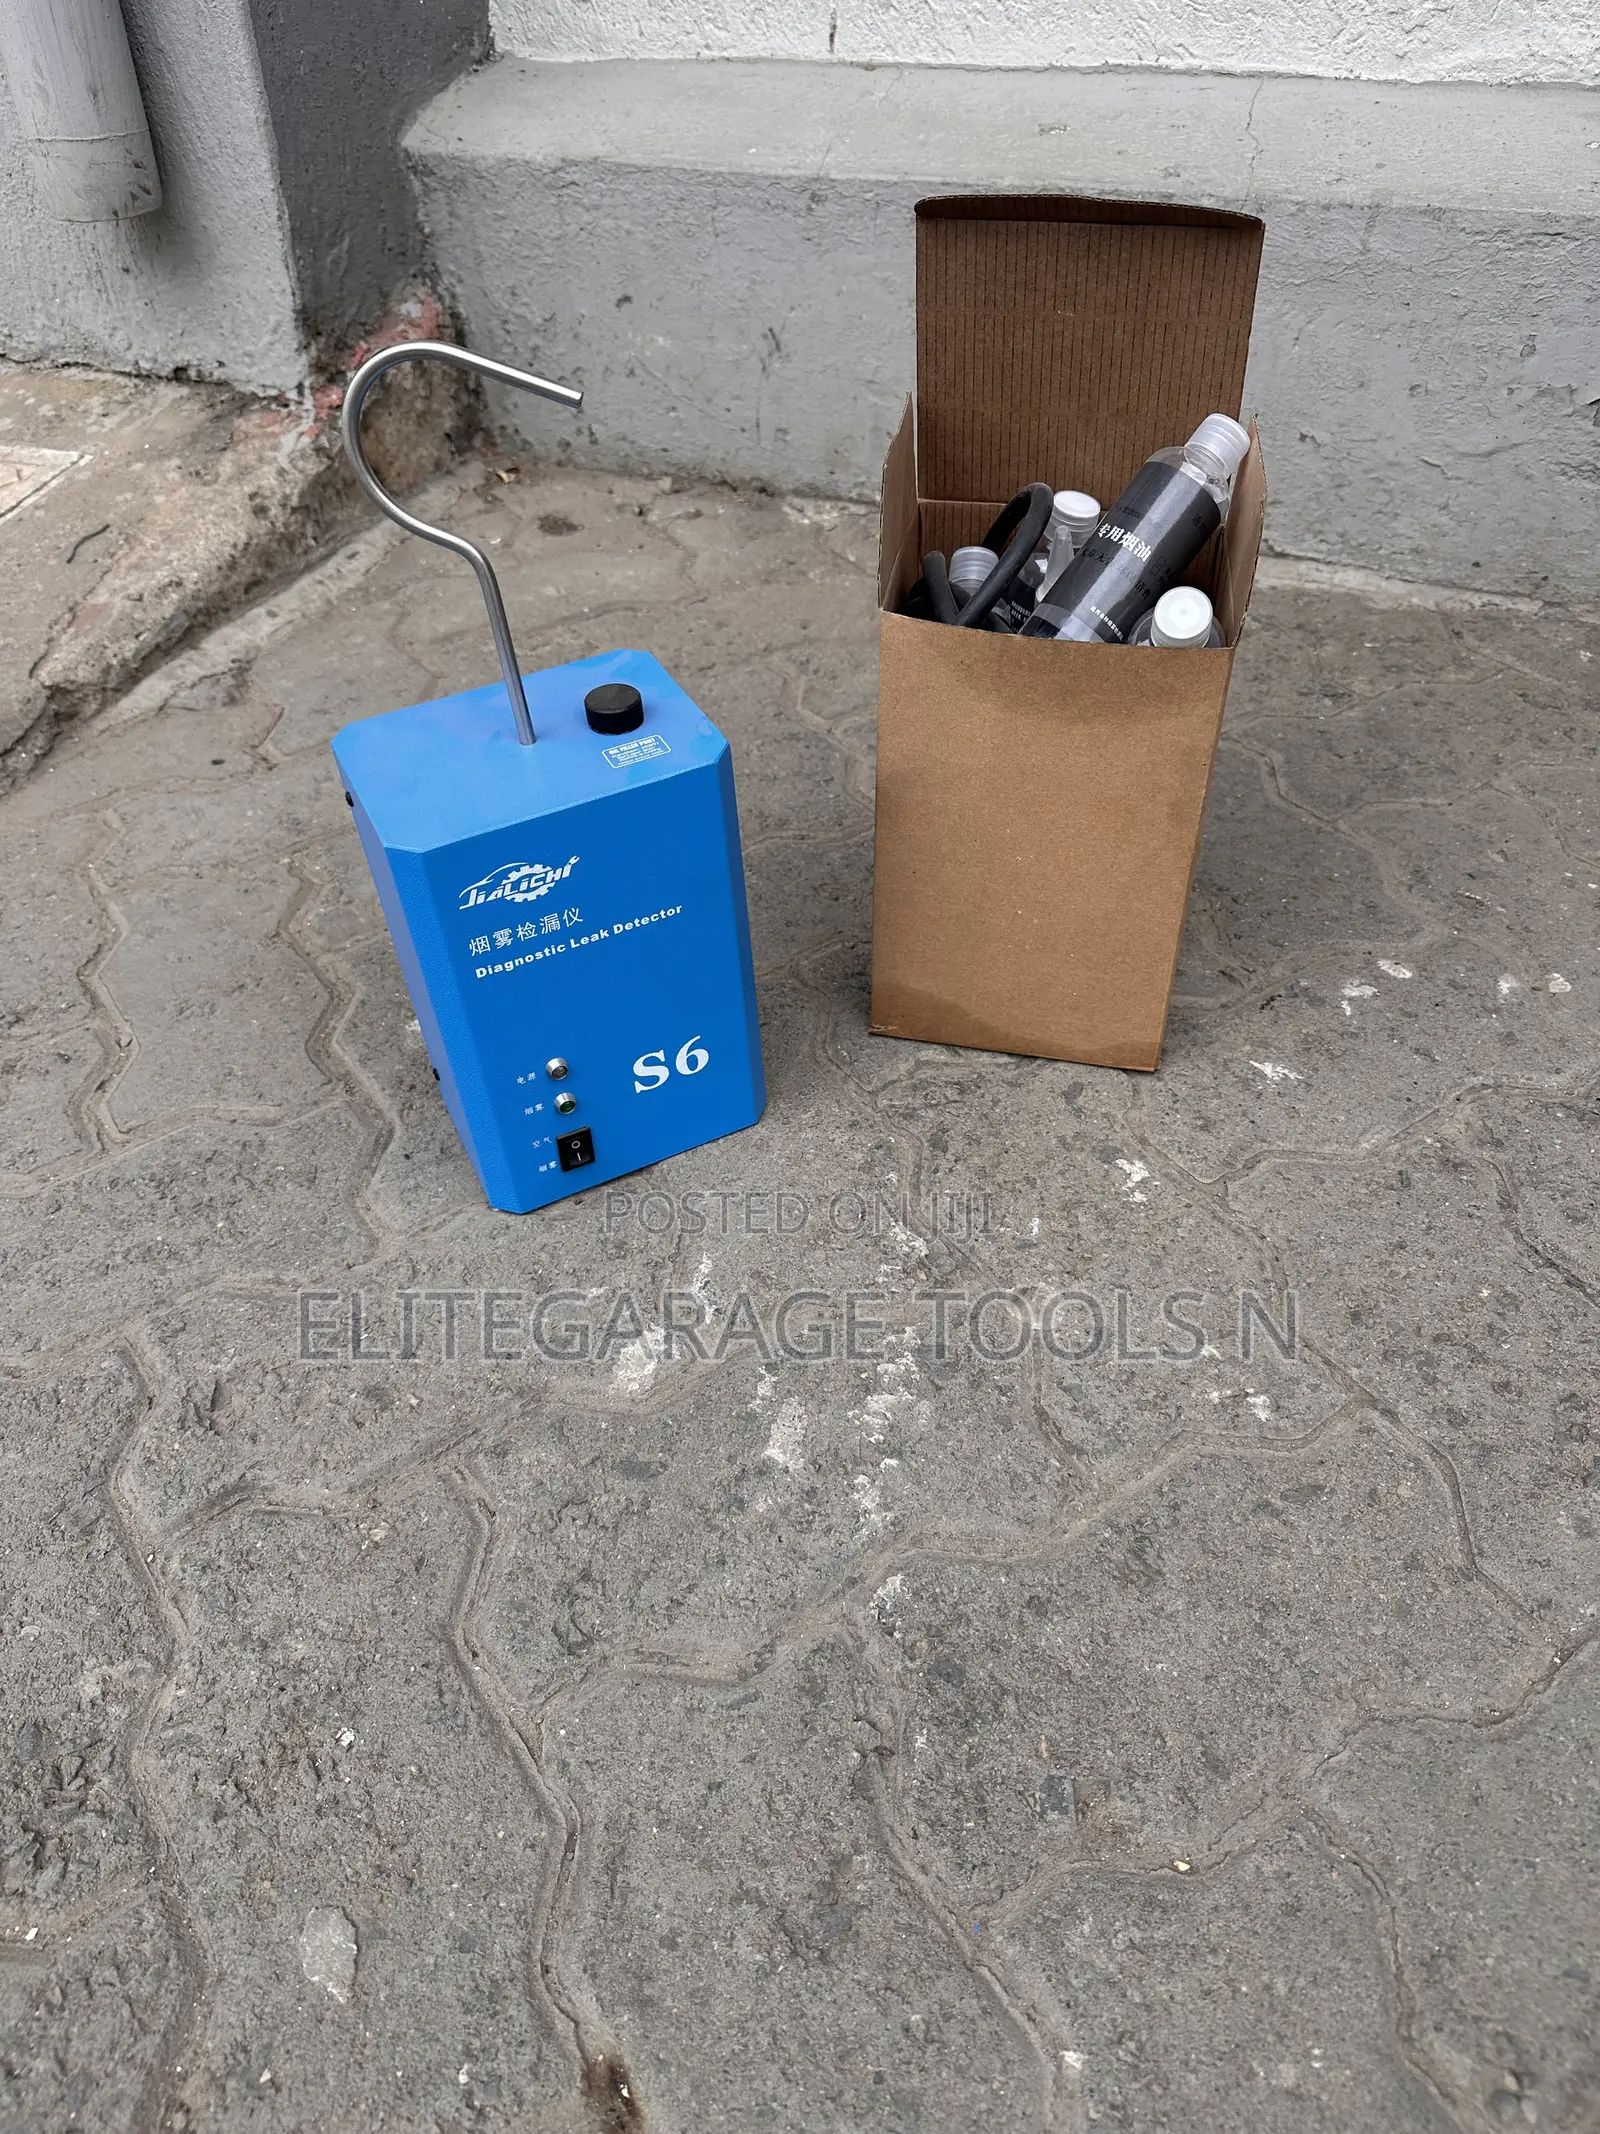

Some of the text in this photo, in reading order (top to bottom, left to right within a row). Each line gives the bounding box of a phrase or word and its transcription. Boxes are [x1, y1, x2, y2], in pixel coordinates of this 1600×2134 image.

[1098, 523, 1152, 562] 专用烟油
[468, 907, 584, 957] 烟雾检漏仪
[475, 904, 683, 979] Diagnostic Leak Detector
[516, 1072, 537, 1085] 电源
[632, 1035, 710, 1094] S6
[524, 1103, 545, 1116] 烟雾
